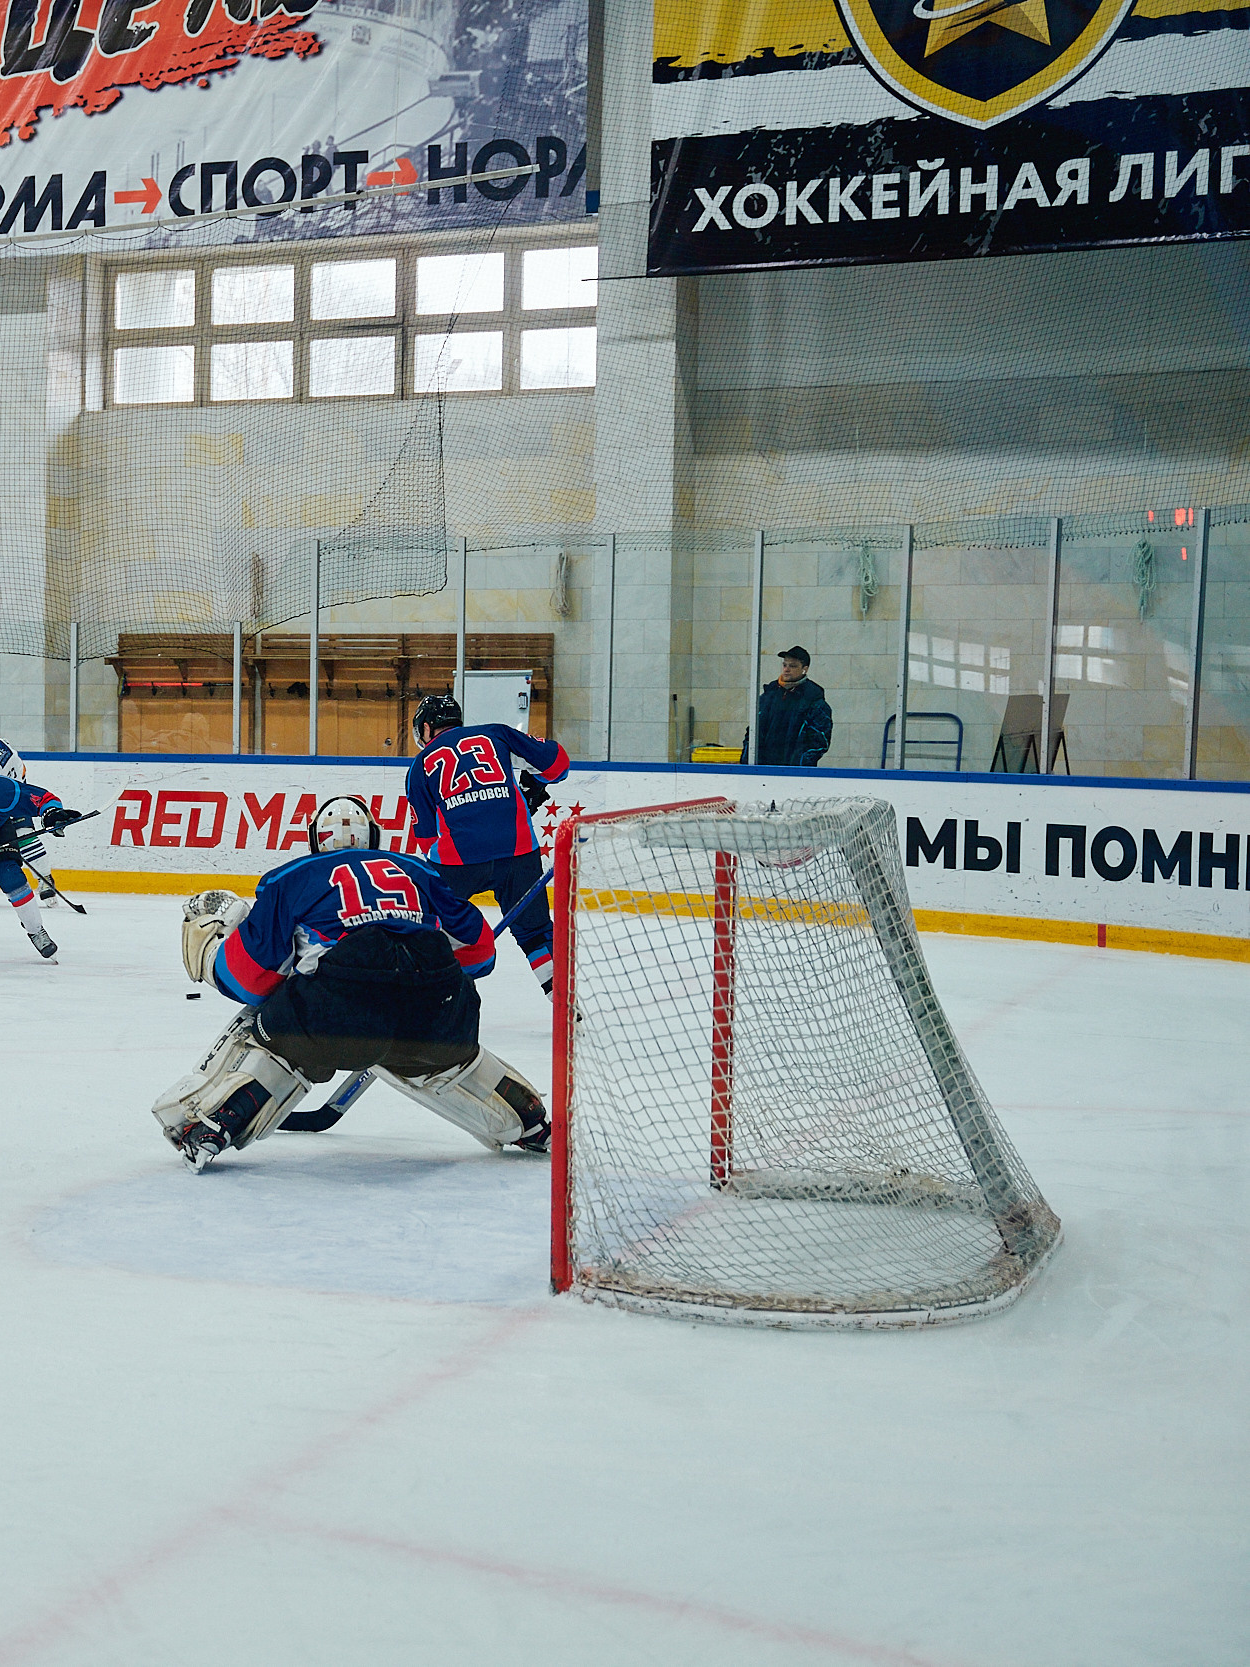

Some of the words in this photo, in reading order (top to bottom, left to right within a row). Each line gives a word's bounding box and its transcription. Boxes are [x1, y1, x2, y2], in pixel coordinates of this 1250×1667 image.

[0, 0, 323, 84] ЦЕ
[169, 150, 368, 217] СПОРТ
[691, 157, 1091, 233] ХОККЕЙНАЯ
[1109, 144, 1250, 204] ЛИГ
[423, 734, 507, 800] 23
[444, 786, 510, 811] ХАБАРОВСК
[110, 789, 229, 848] RED
[905, 817, 1021, 874] МЫ
[1046, 823, 1250, 891] ПОМН
[329, 859, 423, 920] 15
